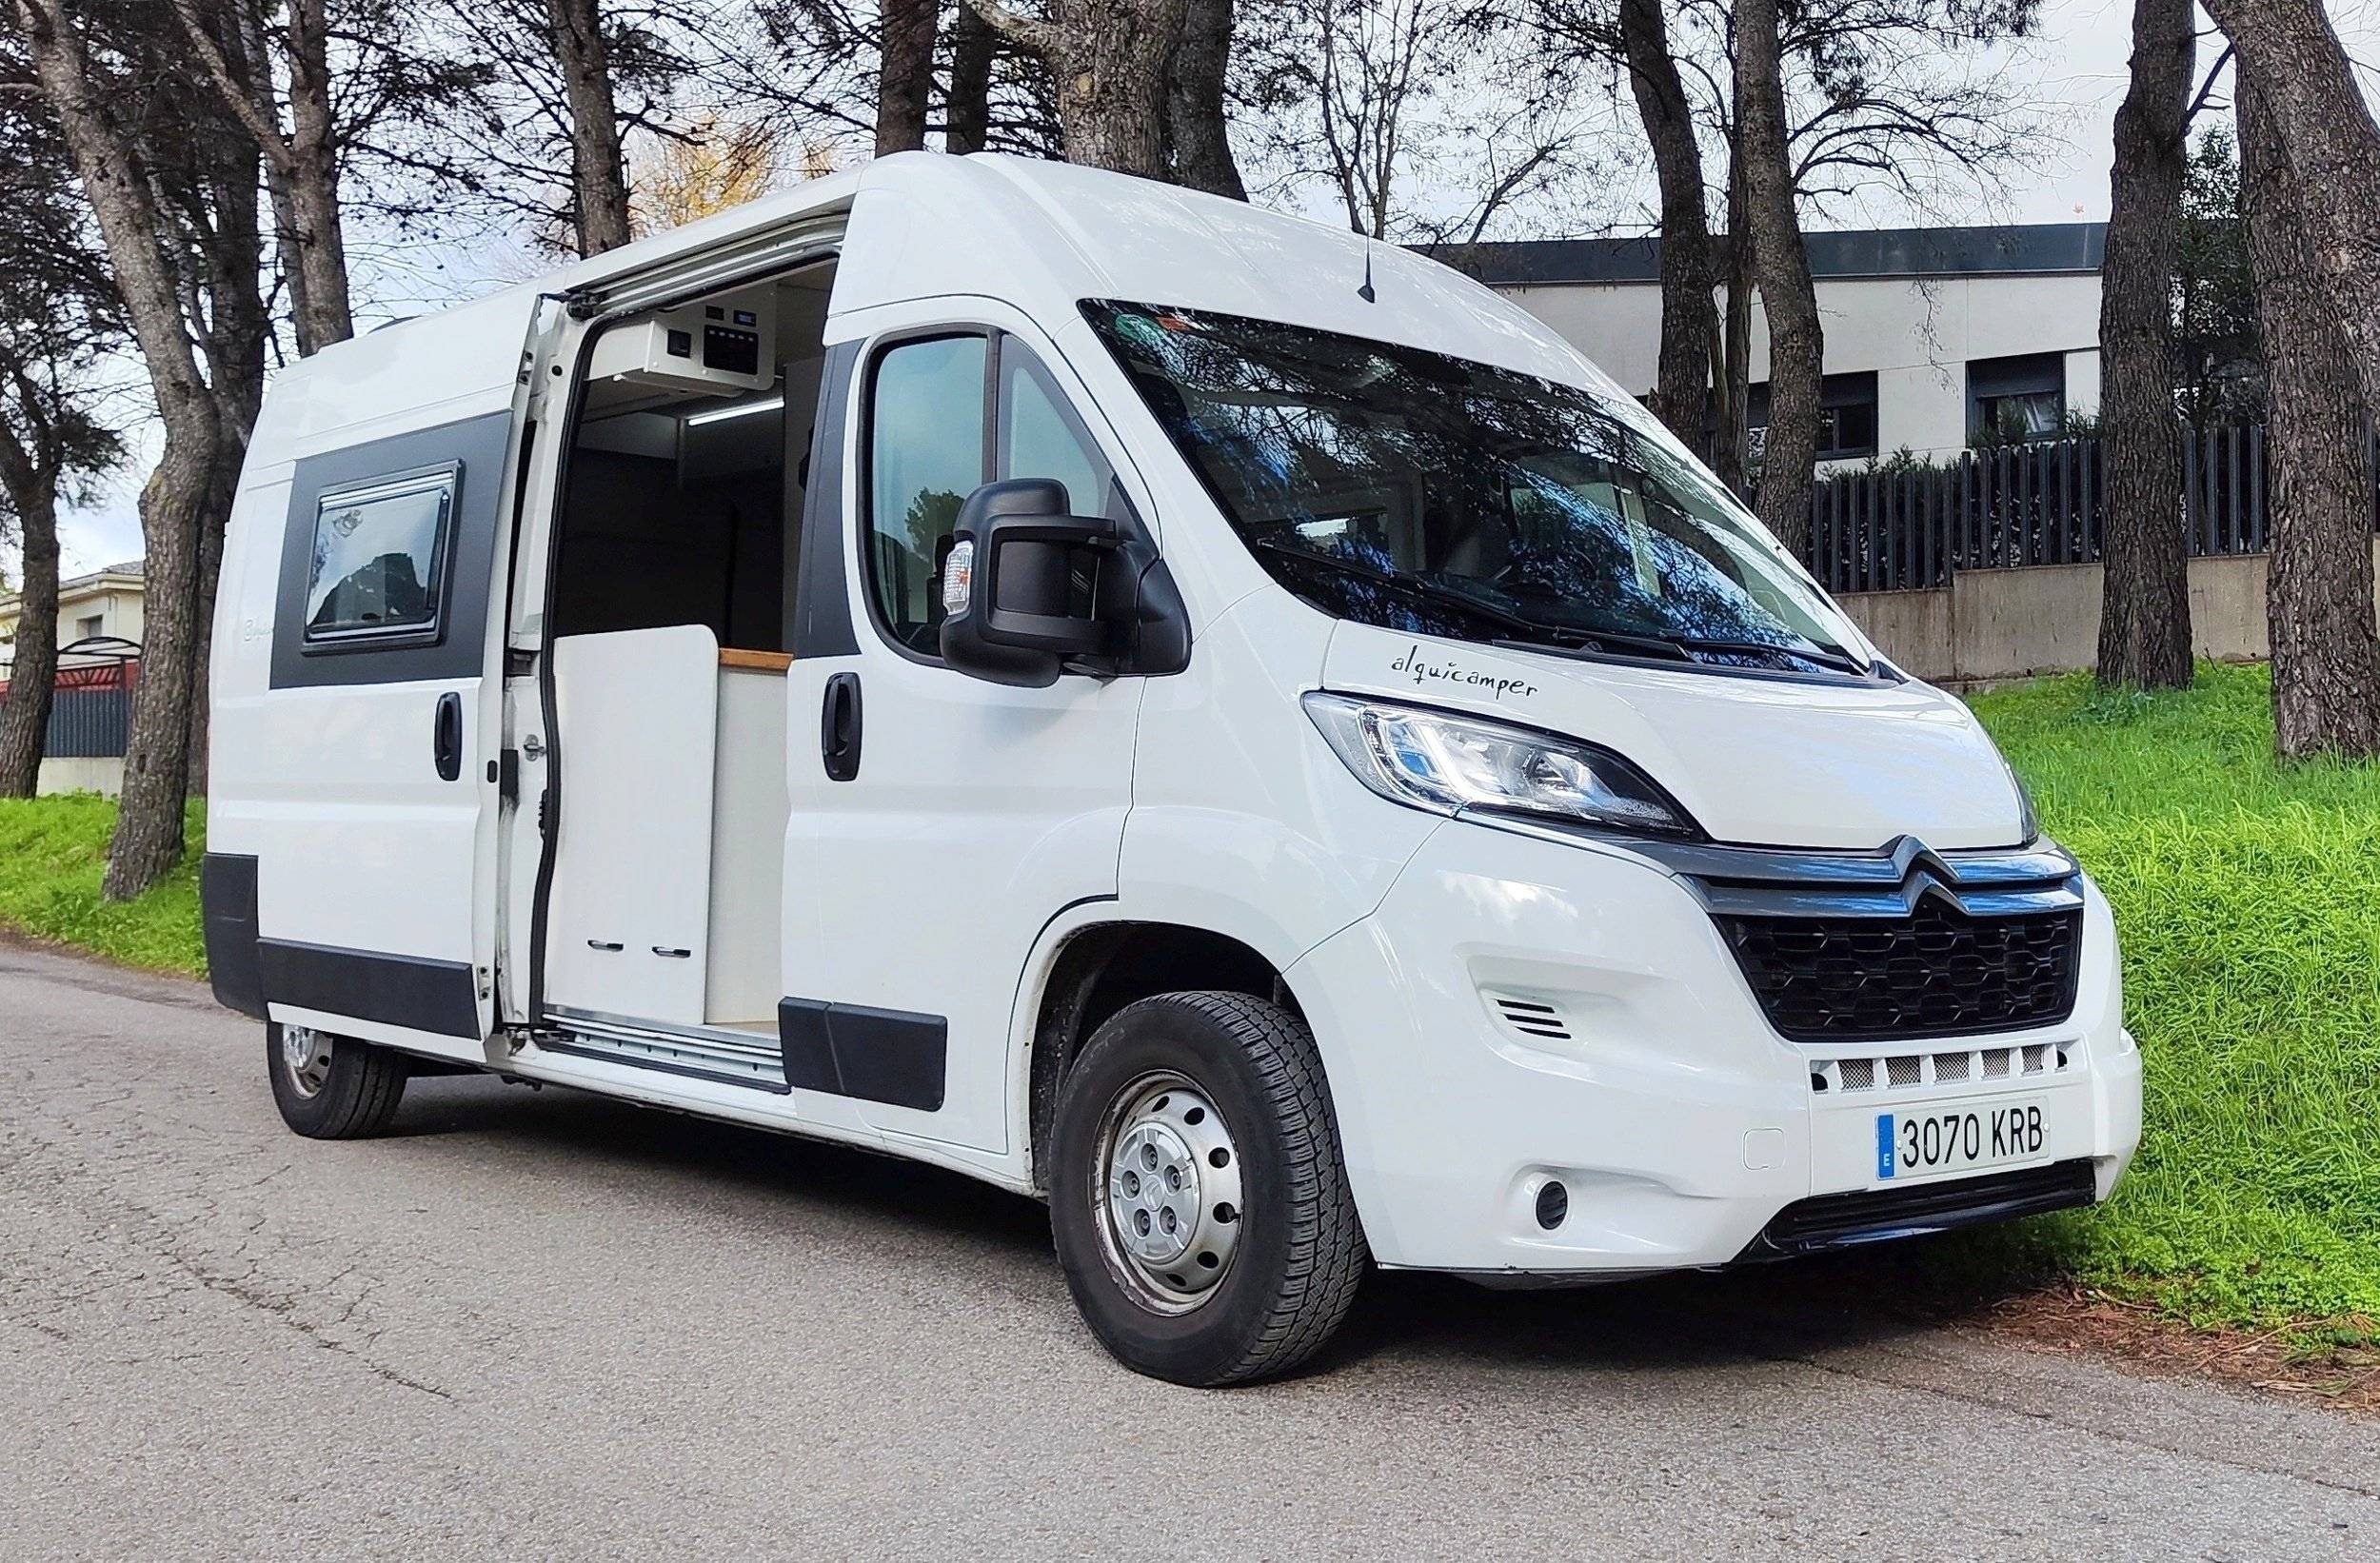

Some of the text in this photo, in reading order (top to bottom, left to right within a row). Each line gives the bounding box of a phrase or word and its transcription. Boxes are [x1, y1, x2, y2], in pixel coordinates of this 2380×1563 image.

[1391, 644, 1538, 701] alquicamper
[1883, 1153, 1891, 1167] E
[1902, 1105, 2043, 1169] 3070 KRB
